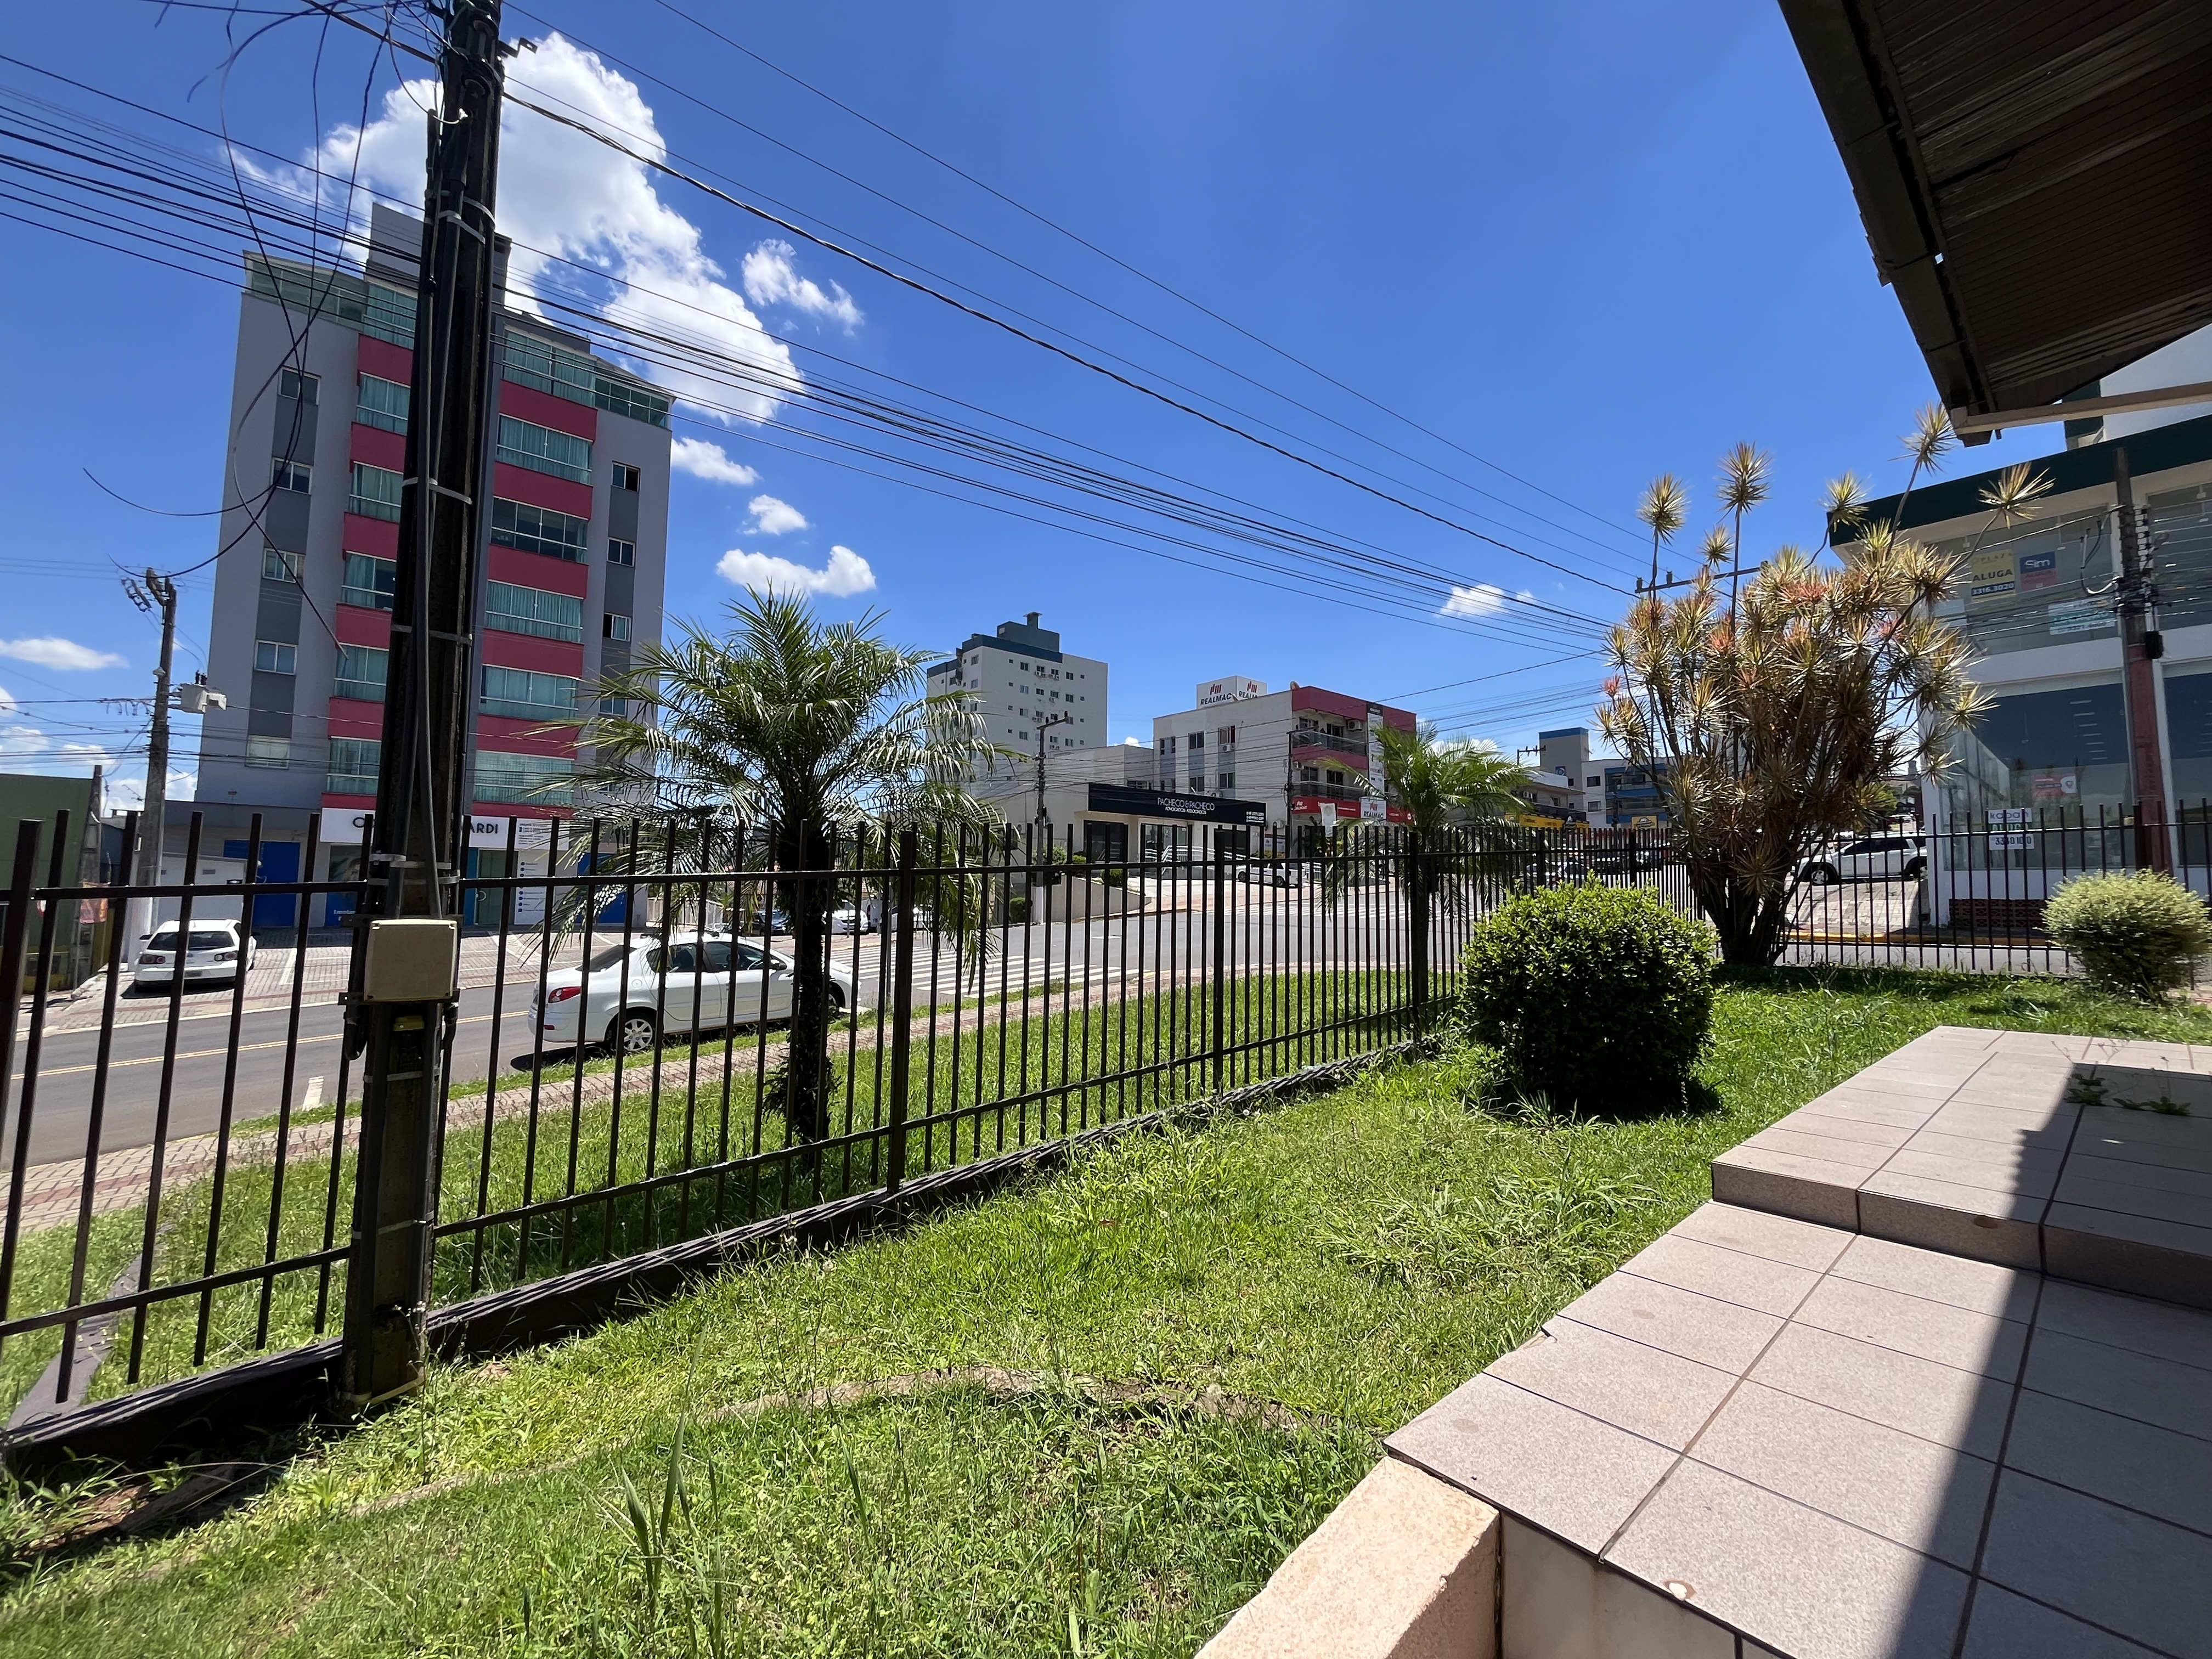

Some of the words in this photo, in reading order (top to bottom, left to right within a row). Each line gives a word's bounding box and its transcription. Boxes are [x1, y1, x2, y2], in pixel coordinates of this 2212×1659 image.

[1972, 568, 2013, 582] ALUGA
[1200, 692, 1232, 706] REALMAC
[1157, 797, 1185, 808] PACHECO
[1189, 800, 1215, 811] PACHECO
